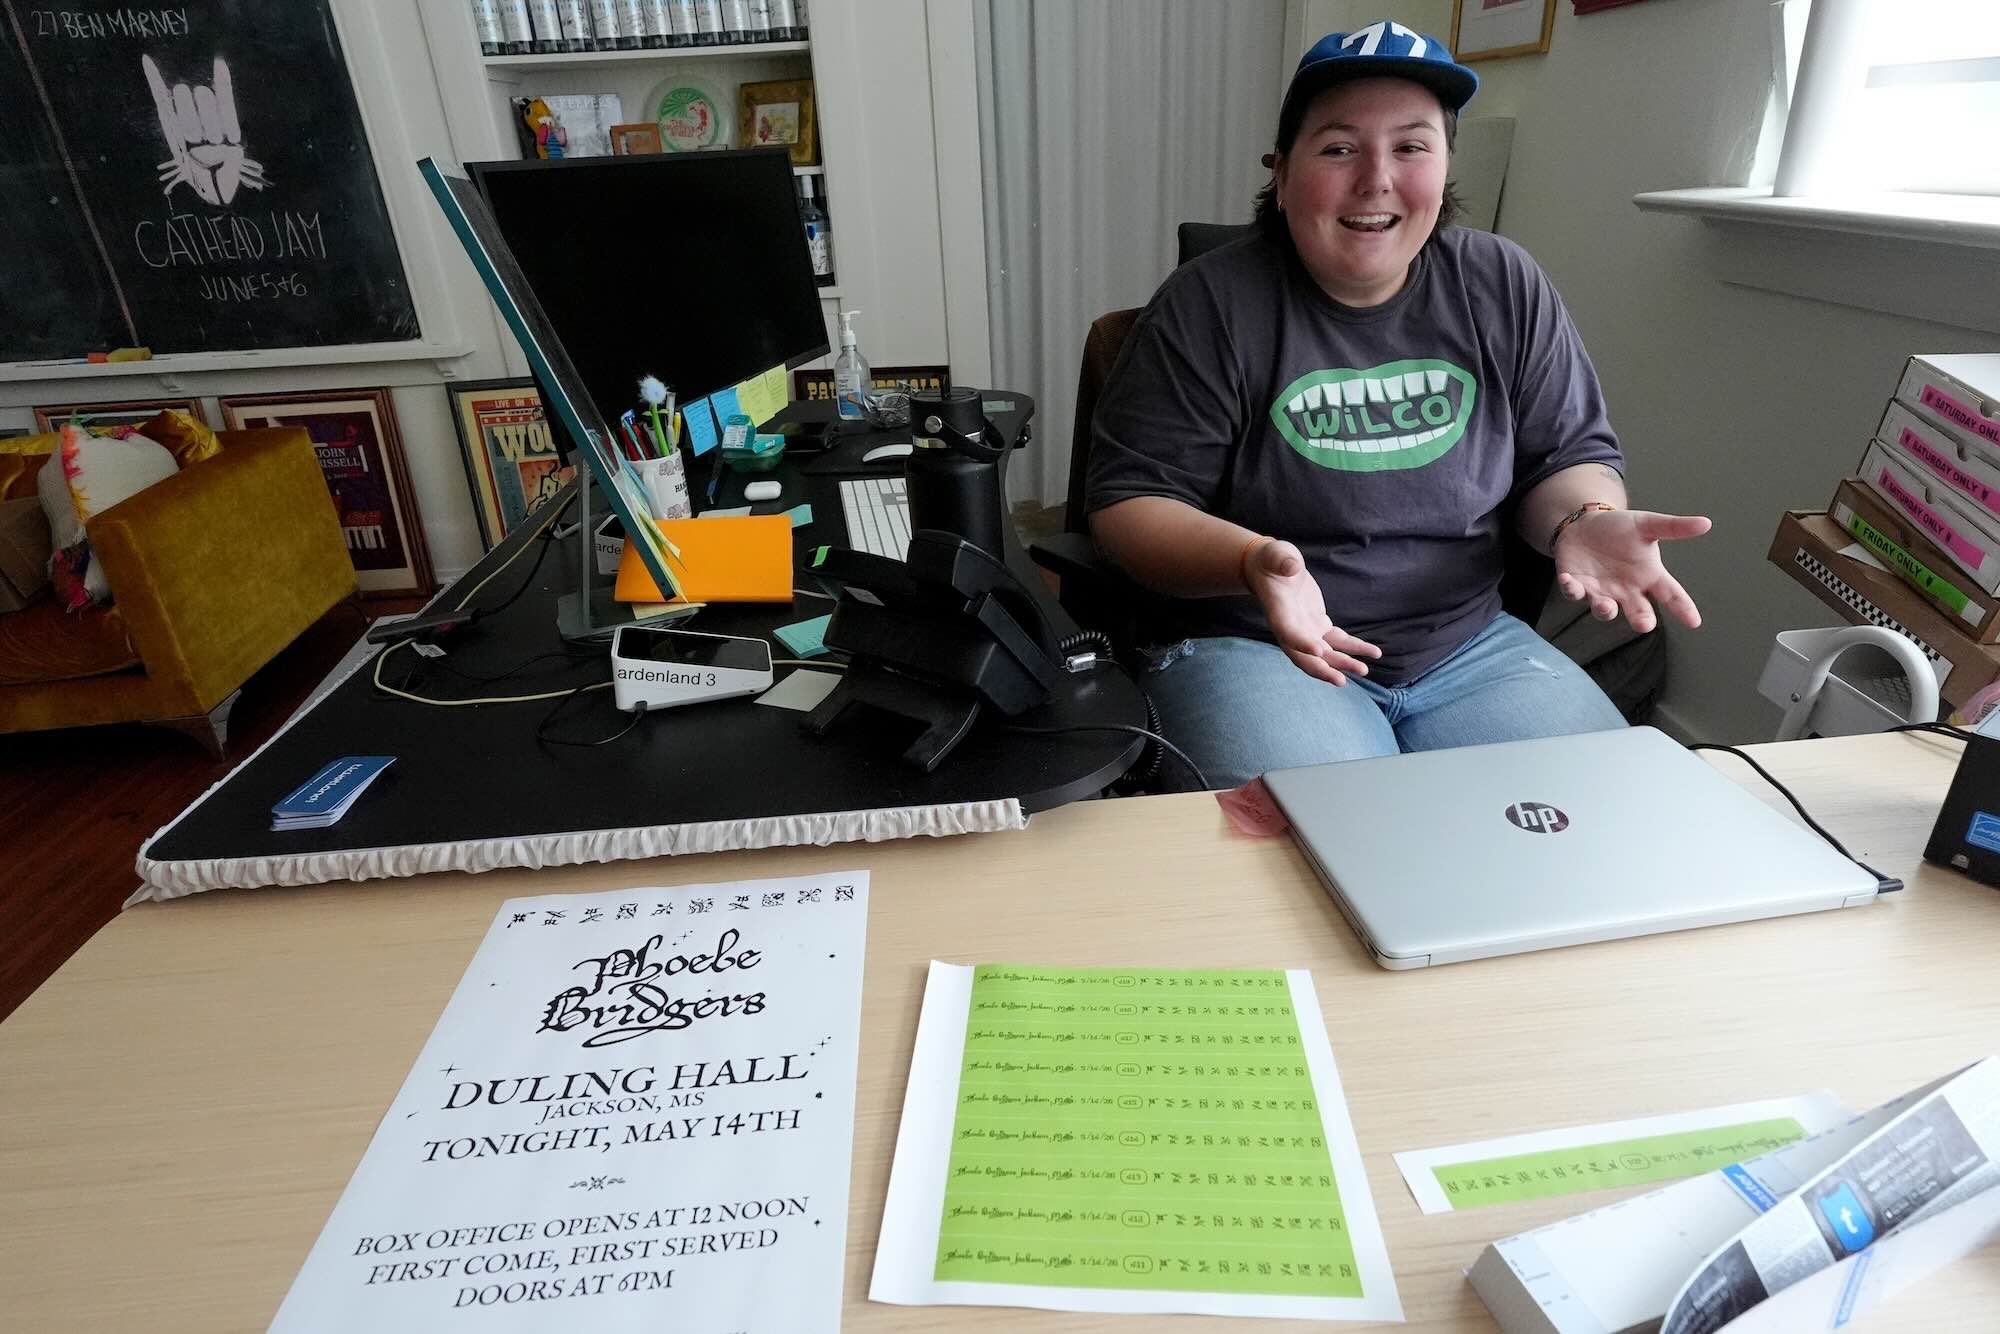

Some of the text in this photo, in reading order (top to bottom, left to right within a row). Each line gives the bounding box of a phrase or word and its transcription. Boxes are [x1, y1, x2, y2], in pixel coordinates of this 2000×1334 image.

[60, 12, 105, 38] BEN
[106, 8, 189, 38] MARNEY
[135, 210, 327, 268] CATHEAD JAM
[200, 274, 261, 302] JUNE
[1935, 398, 1977, 429] SATURDAY
[1912, 440, 1978, 492] SATURDAY ONLY
[1889, 481, 1945, 535] SATURDAY ONLY
[1863, 527, 1922, 577] FRIDAY ONLY
[617, 667, 716, 687] ardenland 3
[1511, 800, 1559, 834] hp
[571, 927, 762, 993] Phoebe
[535, 982, 767, 1048] Bridgers
[439, 1052, 809, 1110] DULING HALL
[534, 1091, 706, 1126] JACKSON, MS
[421, 1126, 613, 1163] TONIGHT,
[623, 1117, 705, 1145] MAY
[352, 1234, 421, 1257] BOX
[425, 1222, 535, 1251] OFFICE
[543, 1211, 641, 1239] OPENS
[643, 1207, 687, 1227] AT
[717, 1196, 810, 1220] NOON
[364, 1228, 780, 1286] FIRST COME, FIRST SERVED
[452, 1270, 674, 1308] DOORS AT 6PM
